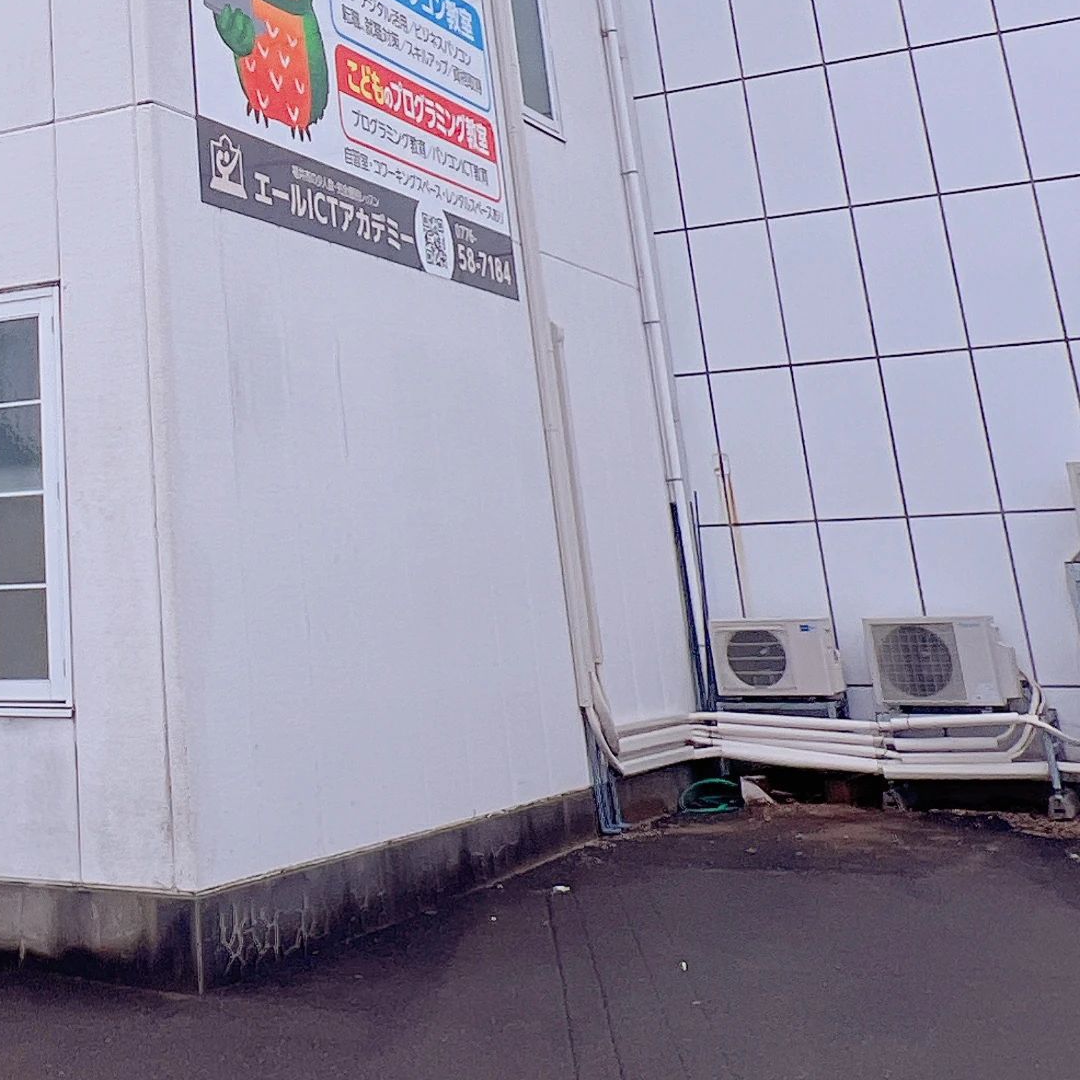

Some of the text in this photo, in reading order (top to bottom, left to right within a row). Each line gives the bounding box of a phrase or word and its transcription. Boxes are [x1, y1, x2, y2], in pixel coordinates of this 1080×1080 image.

[345, 59, 490, 156] こどものプログラミング教室
[253, 170, 416, 253] エールICTアカデミー
